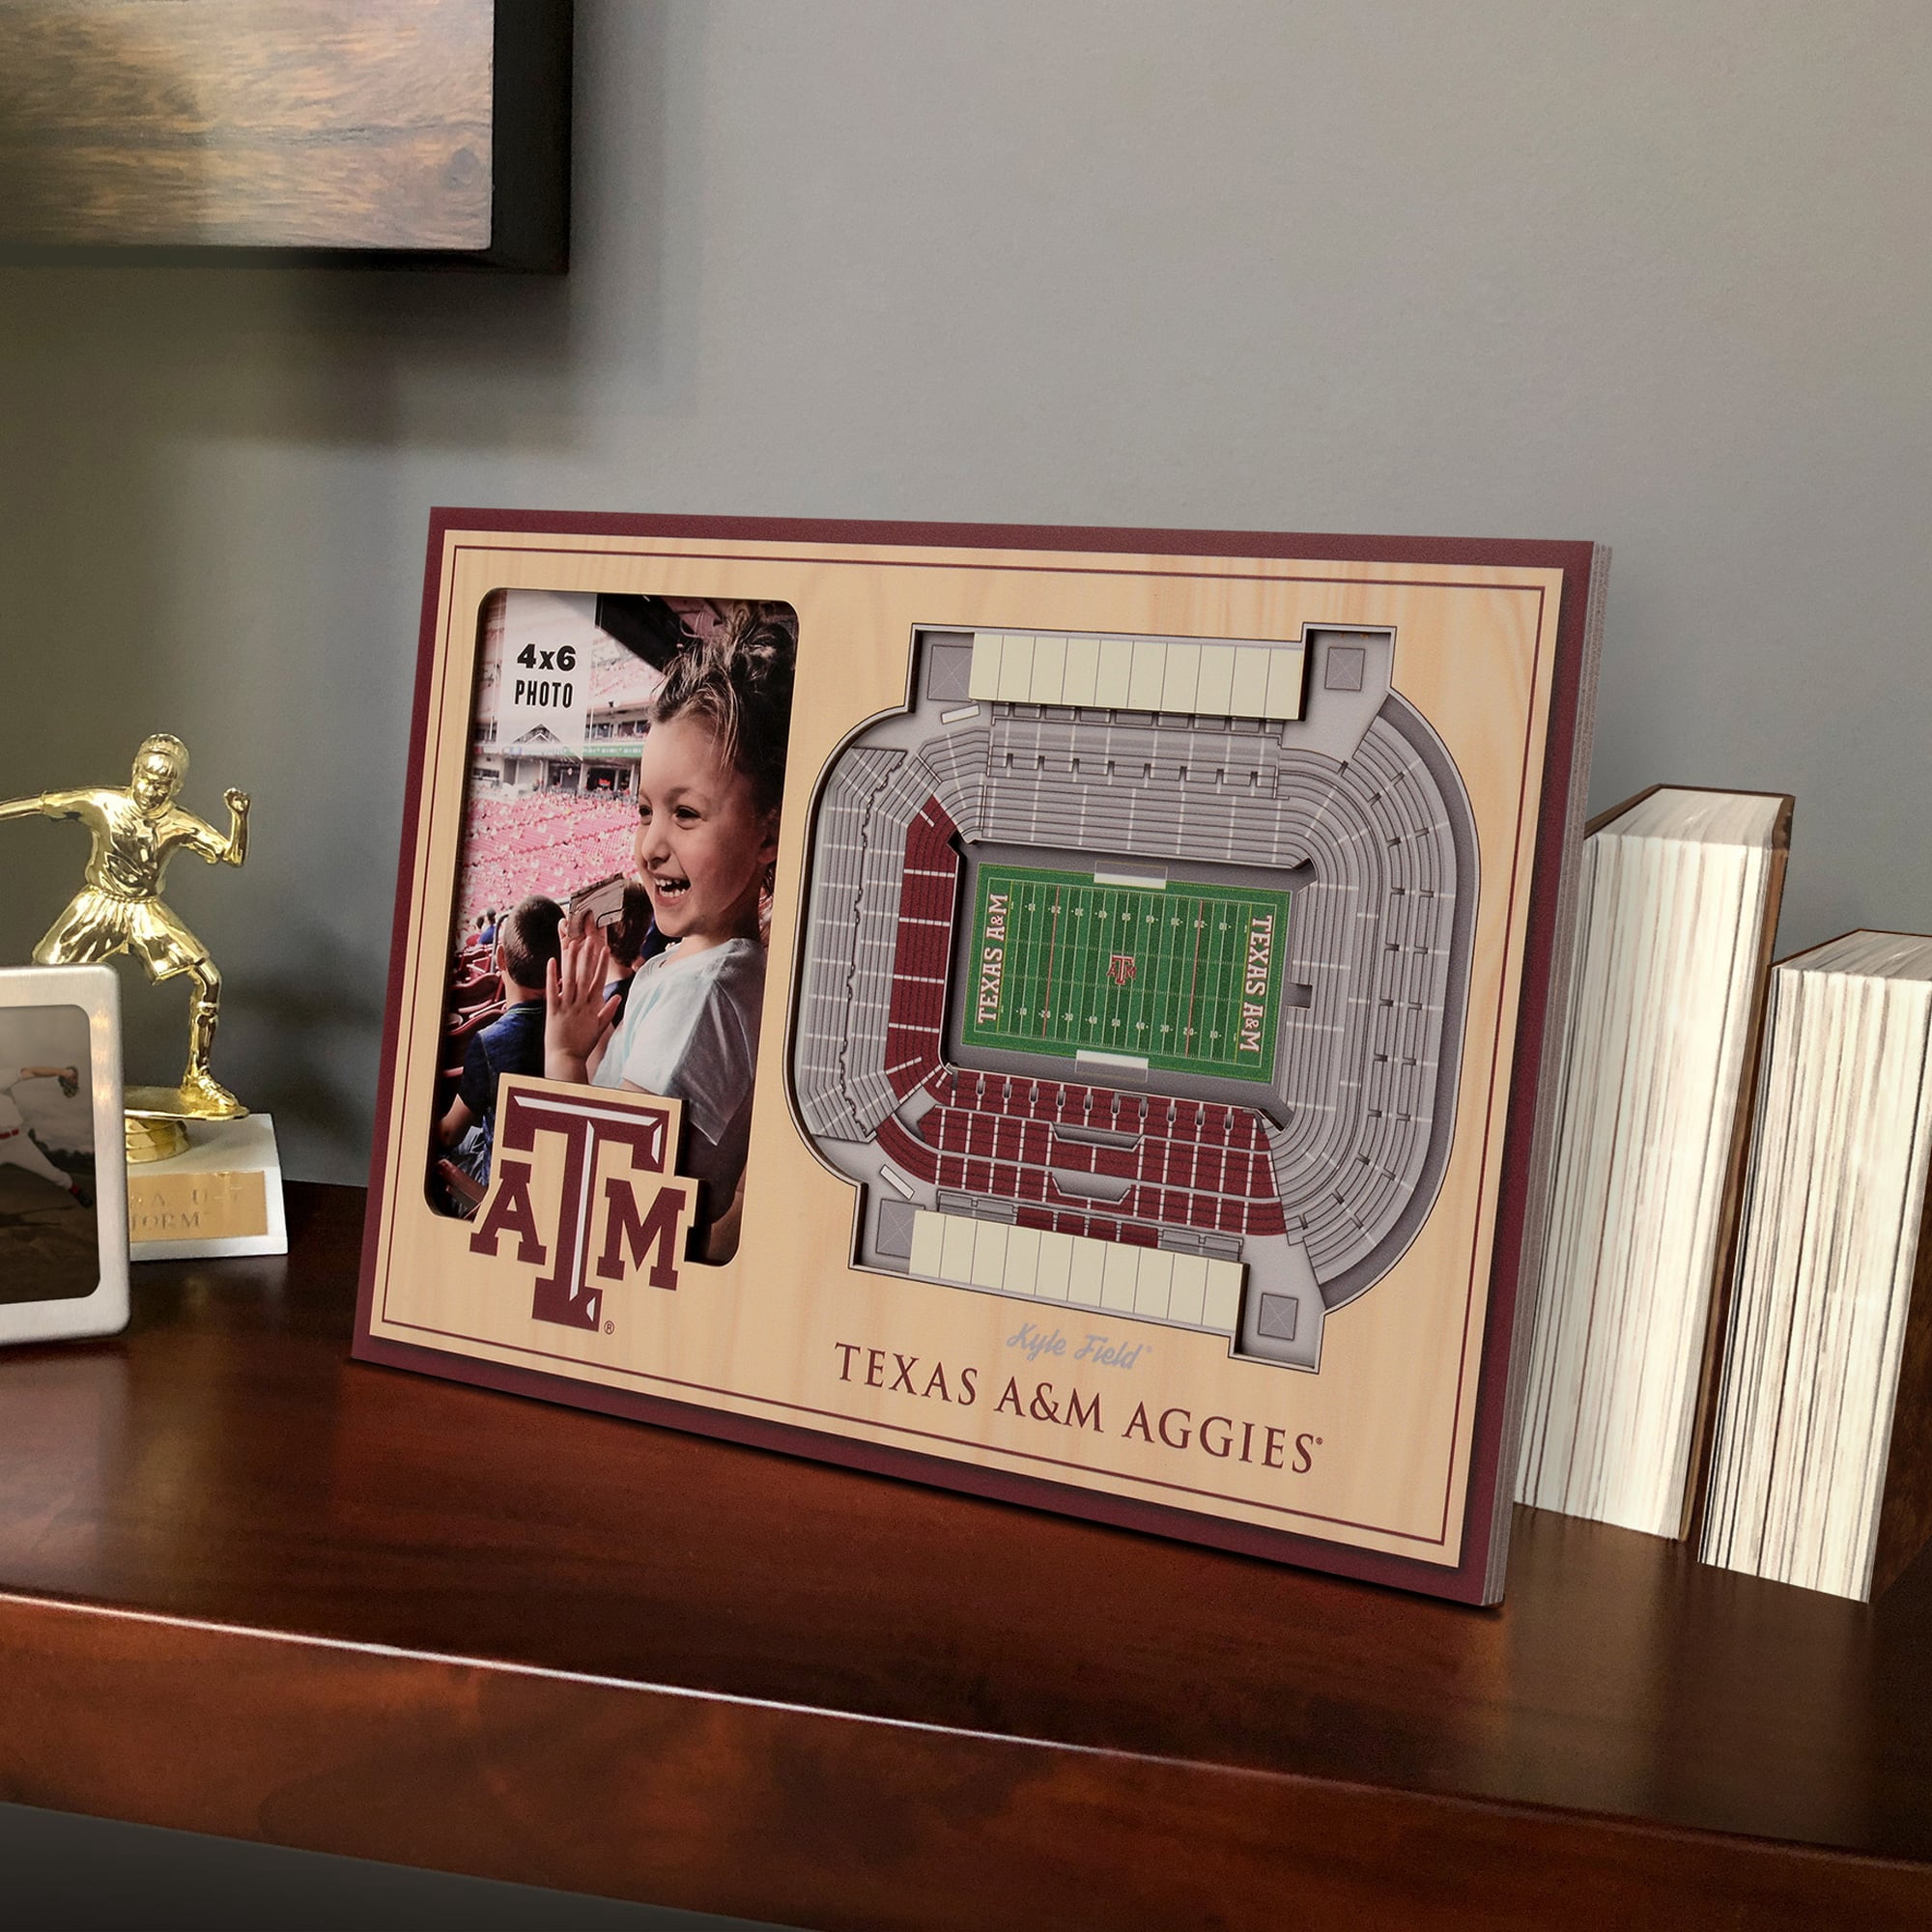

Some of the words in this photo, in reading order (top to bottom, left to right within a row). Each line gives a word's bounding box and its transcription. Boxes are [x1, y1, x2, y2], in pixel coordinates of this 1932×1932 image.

[516, 642, 576, 671] 4x6
[514, 679, 574, 708] PHOTO
[985, 894, 1009, 942] A&M
[1245, 915, 1273, 997] TEXAS
[978, 946, 1004, 1024] TEXAS
[1239, 1002, 1264, 1052] A&M
[1006, 1322, 1067, 1361] Kyle
[1074, 1334, 1144, 1370] Field
[834, 1342, 978, 1406] TEXAS
[993, 1376, 1105, 1434] A&M
